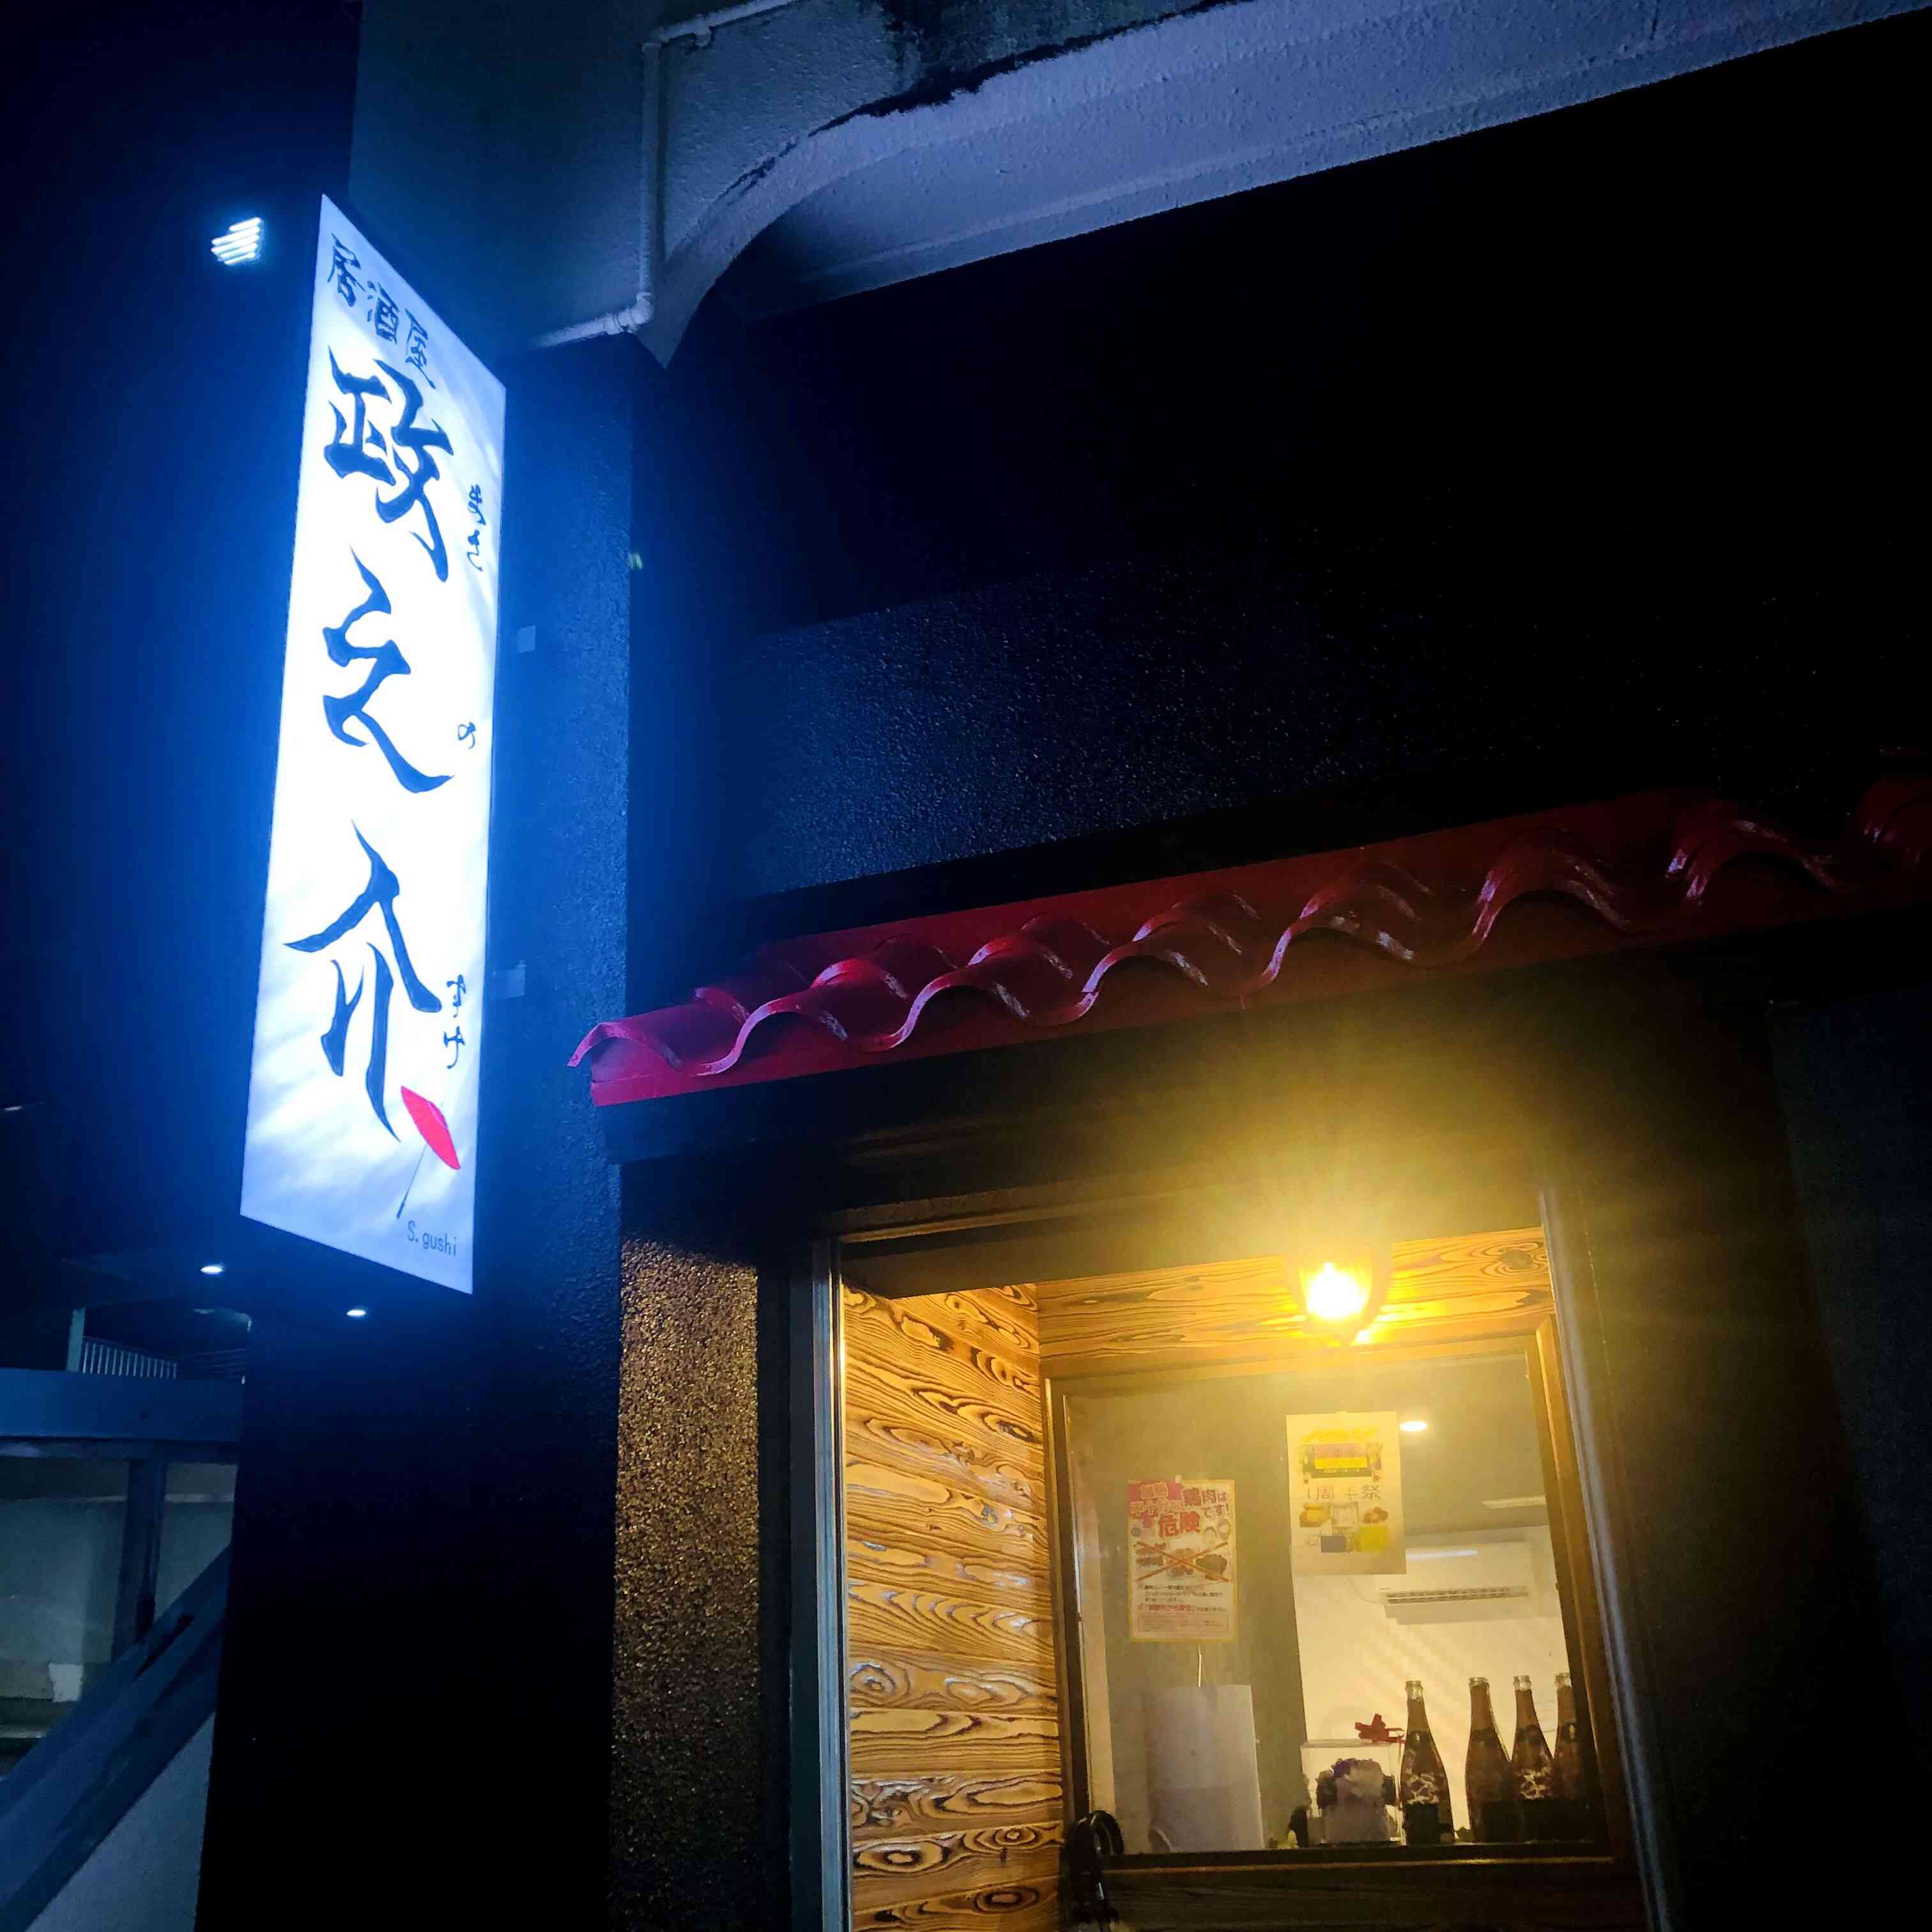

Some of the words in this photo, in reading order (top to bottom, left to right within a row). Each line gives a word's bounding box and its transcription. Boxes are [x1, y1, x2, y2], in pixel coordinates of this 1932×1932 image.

[326, 232, 436, 390] 居酒屋
[282, 343, 456, 1143] 政之介
[408, 1220, 419, 1243] S.
[422, 1233, 457, 1257] gushi
